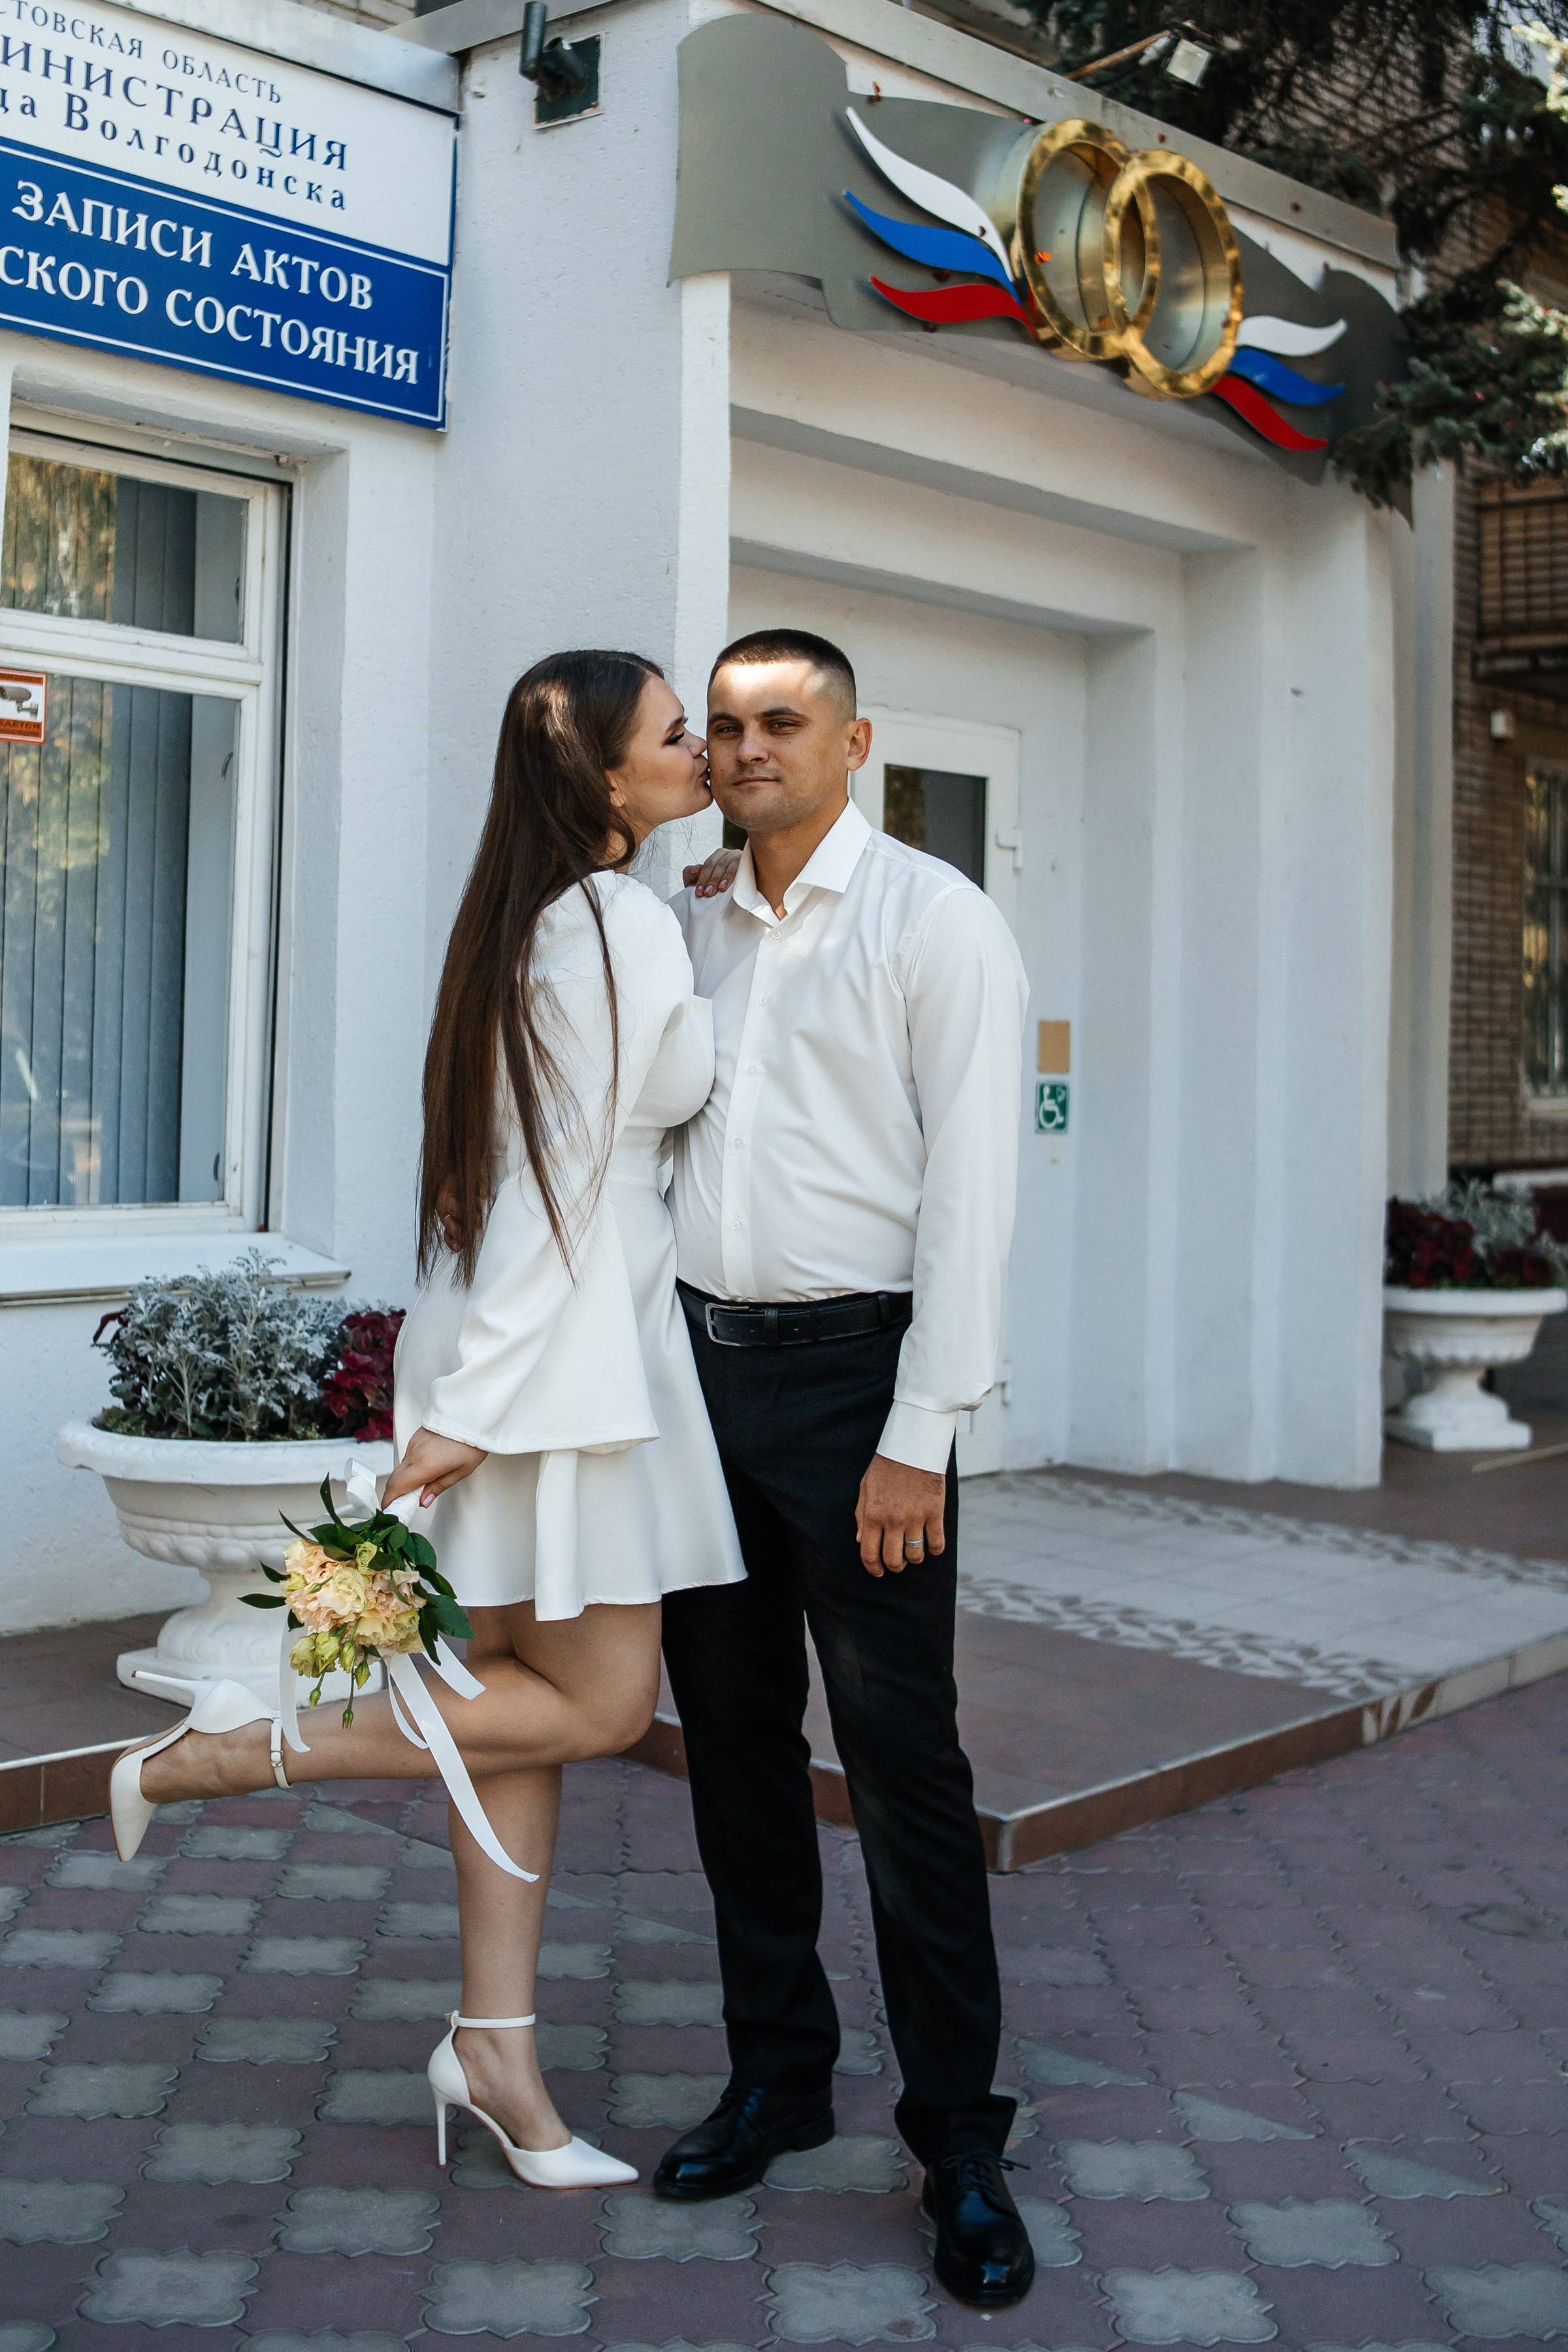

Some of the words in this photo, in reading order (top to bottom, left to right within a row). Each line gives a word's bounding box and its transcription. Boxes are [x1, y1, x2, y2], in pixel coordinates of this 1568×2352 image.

[0, 0, 142, 59] ТОВСКАЯ
[162, 50, 282, 104] ОБЛАСТЬ
[0, 34, 348, 172] ИНИСТРАЦИЯ
[63, 91, 346, 211] Волгодонска
[11, 180, 213, 268] ЗАПИСИ
[230, 243, 372, 310] АКТОВ
[0, 246, 148, 314] СКОГО
[165, 289, 418, 384] СОСТОЯНИЯ
